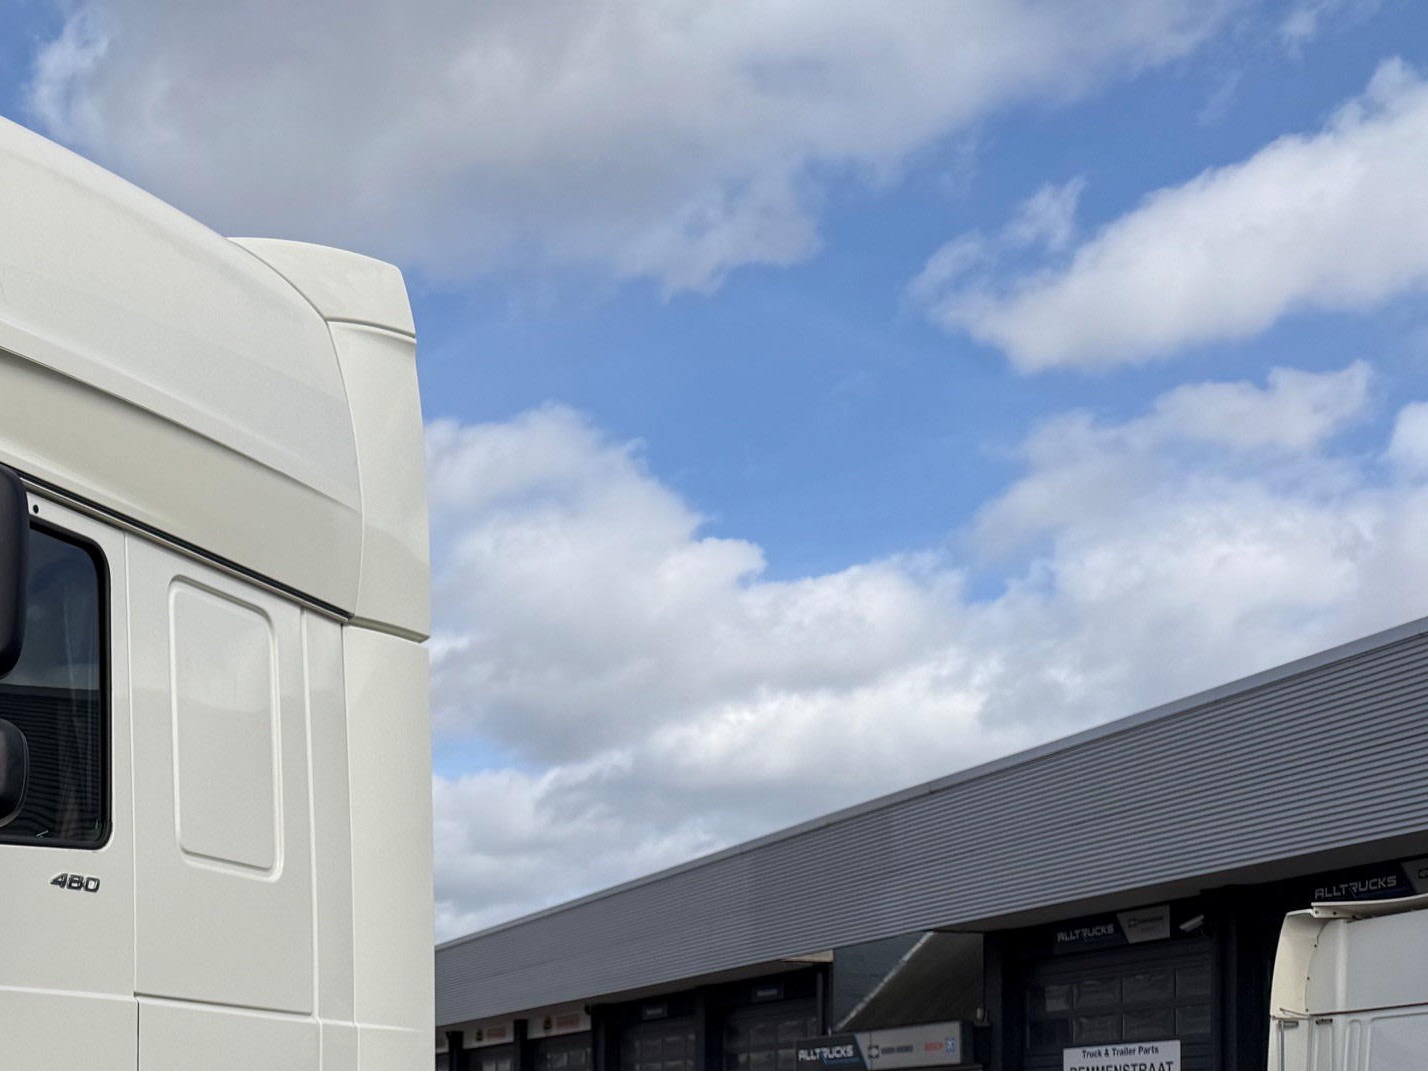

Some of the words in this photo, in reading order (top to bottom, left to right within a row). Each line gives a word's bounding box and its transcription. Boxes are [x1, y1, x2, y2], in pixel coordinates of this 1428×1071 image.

[50, 873, 101, 893] 480
[1314, 875, 1397, 900] ALLTRUCKS
[1056, 923, 1115, 943] ALLTRUCKS
[797, 1043, 855, 1062] ALLTRUCKS
[1081, 1049, 1103, 1059] Truck
[1104, 1048, 1110, 1058] &
[1112, 1046, 1137, 1057] Trailer
[1138, 1045, 1159, 1056] Parts
